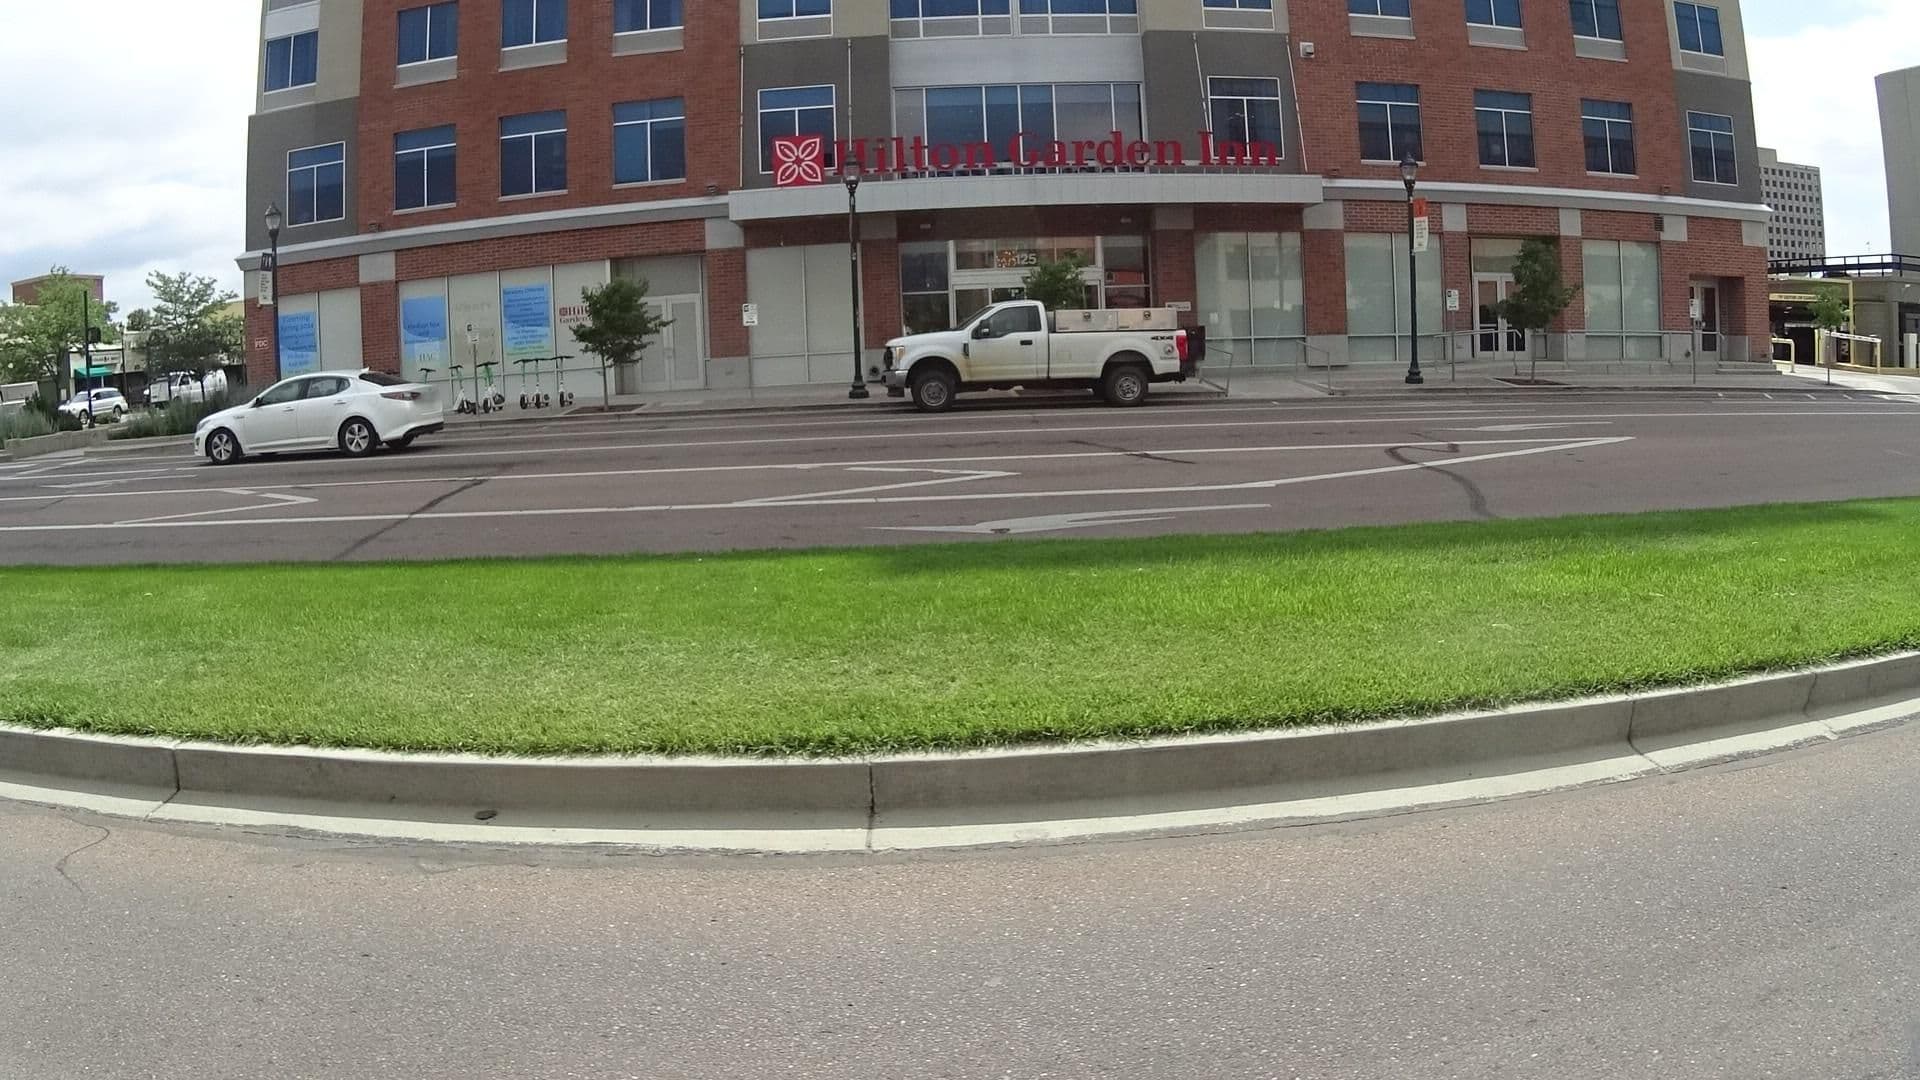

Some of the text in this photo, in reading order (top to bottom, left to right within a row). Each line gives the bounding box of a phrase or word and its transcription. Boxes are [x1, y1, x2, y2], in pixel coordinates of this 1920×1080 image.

[834, 130, 1280, 175] Hilton Garden Inn
[1015, 253, 1037, 265] 125
